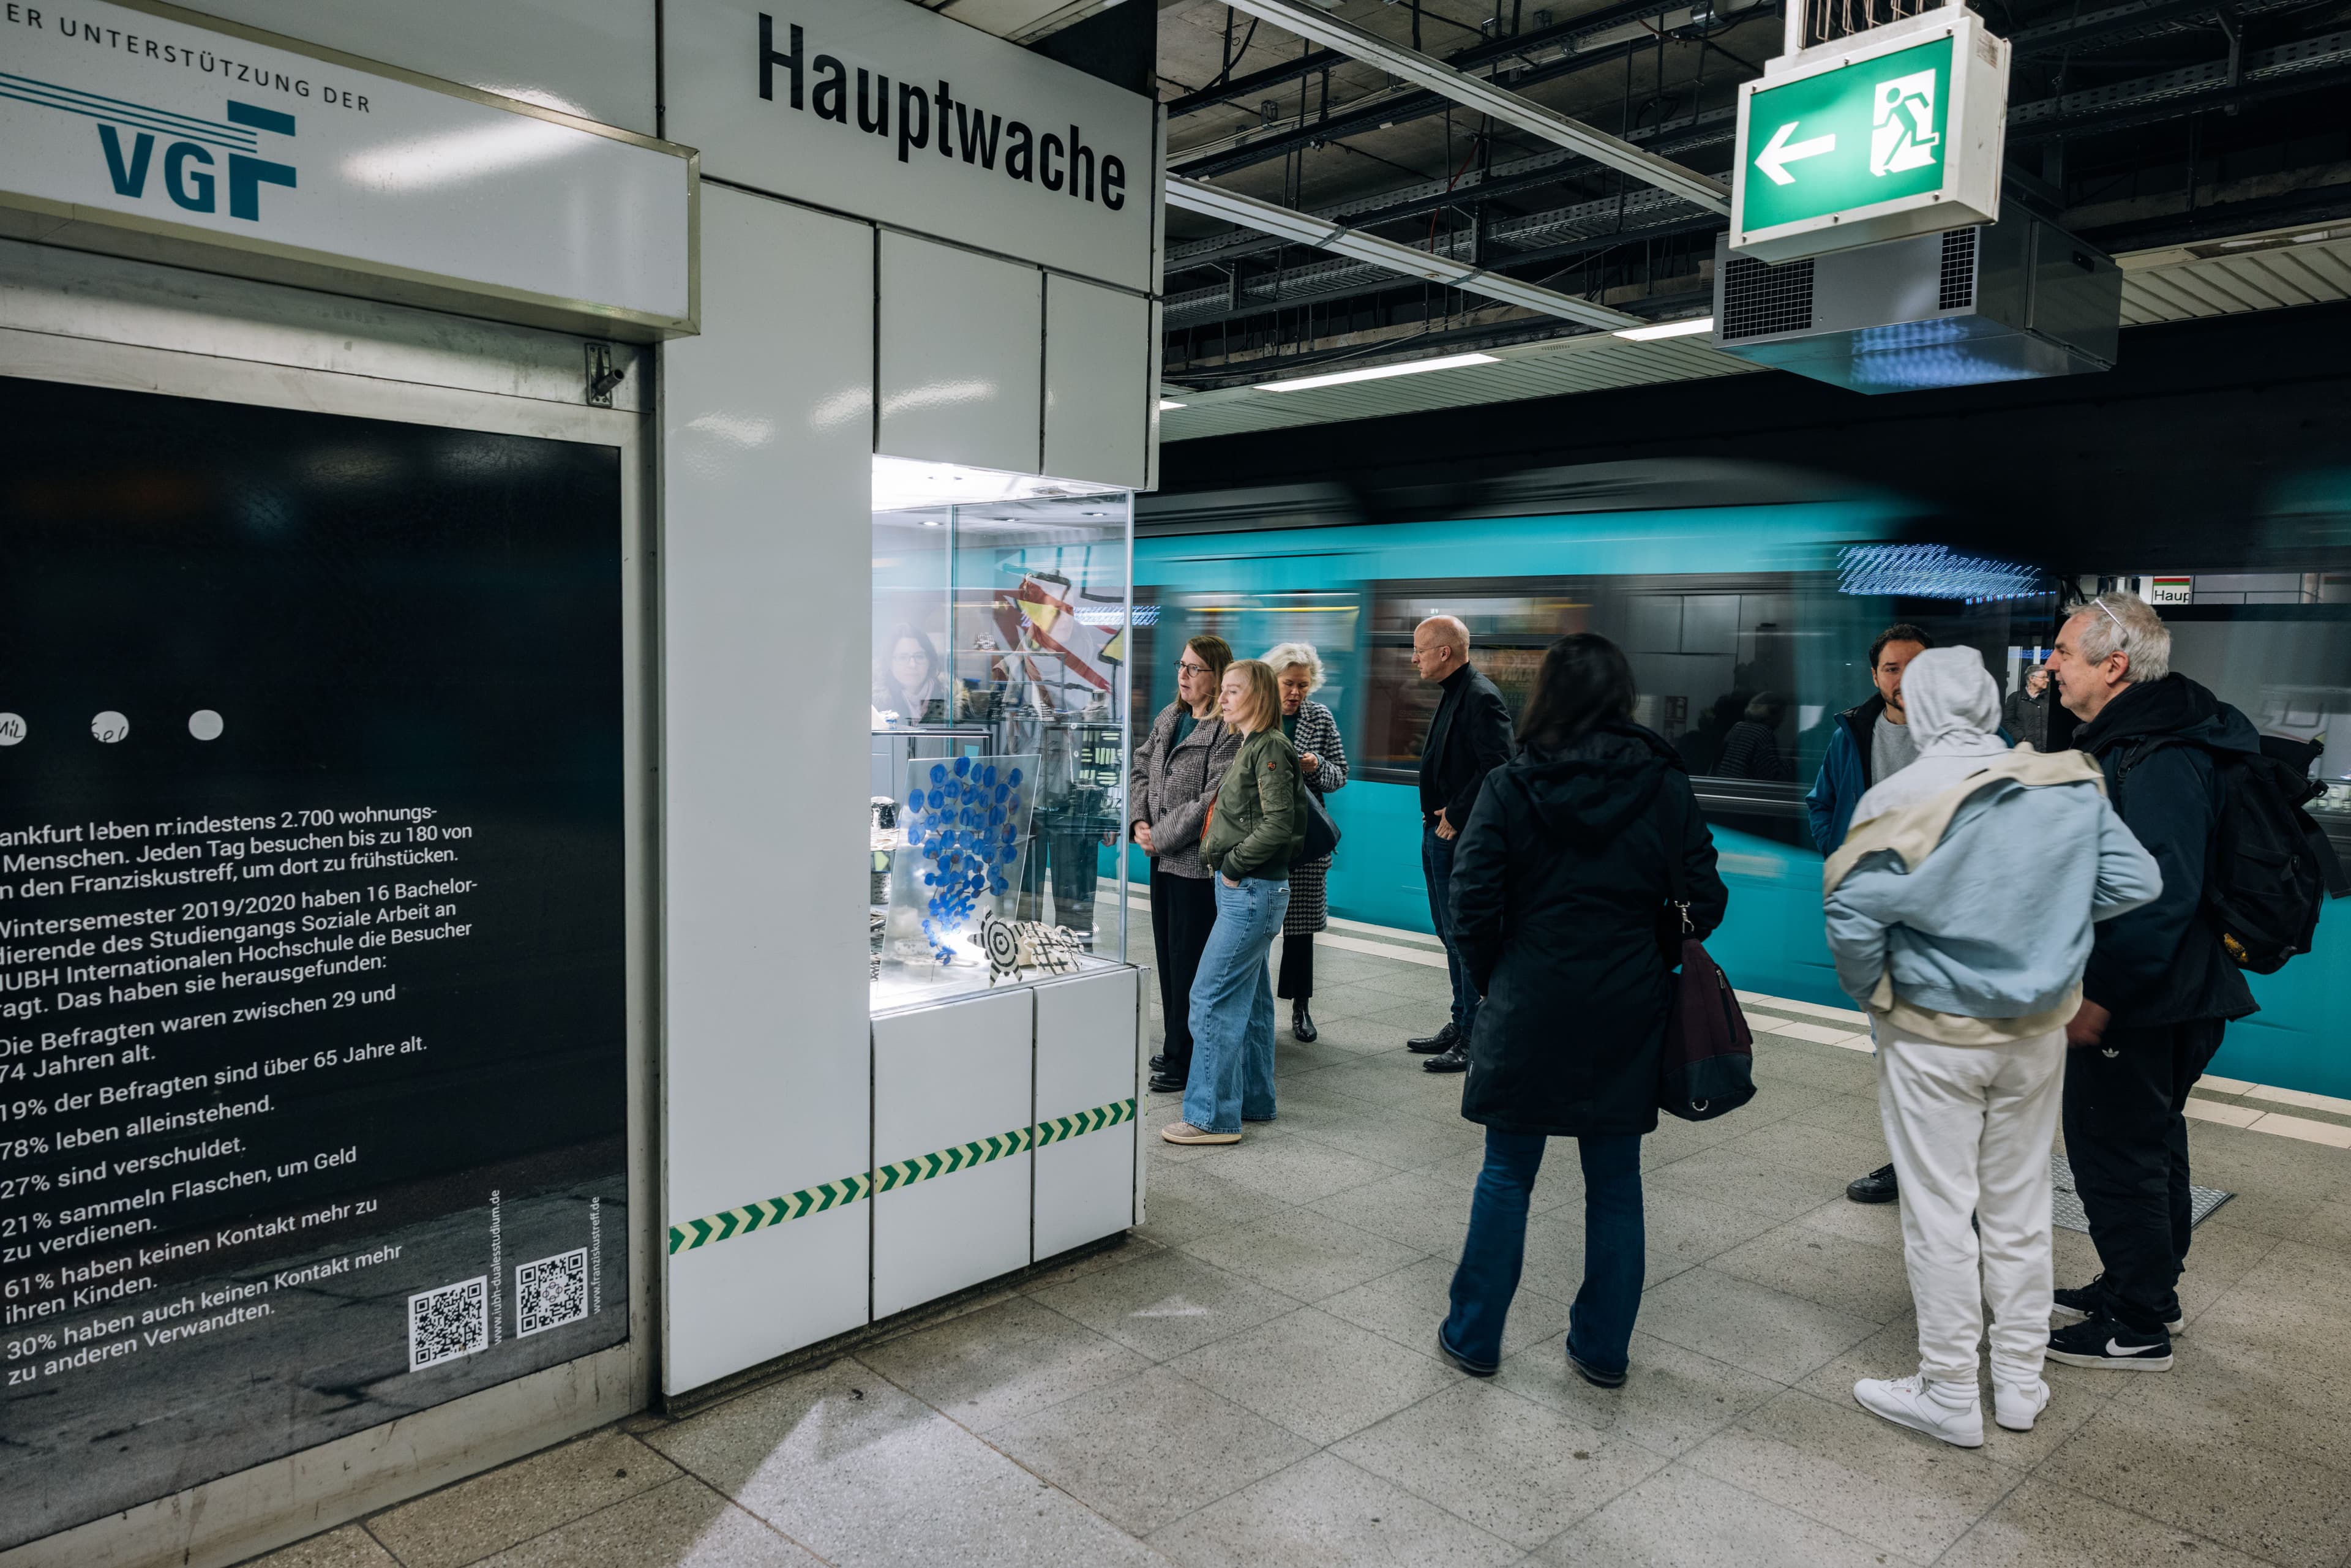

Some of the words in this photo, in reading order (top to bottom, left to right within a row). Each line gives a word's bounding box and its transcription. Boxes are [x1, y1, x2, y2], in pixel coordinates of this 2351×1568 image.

[6, 3, 43, 30] ER
[60, 17, 310, 98] UNTERSTÜTZUNG
[323, 86, 370, 113] DER
[758, 12, 1126, 212] Hauptwache
[97, 99, 297, 222] VGF
[3, 848, 130, 873] Menschen.
[136, 842, 201, 863] Jeden
[206, 840, 245, 860] Tag
[250, 833, 343, 854] besuchen
[348, 829, 376, 847] bis
[380, 831, 401, 845] zu
[406, 825, 438, 842] 180
[441, 826, 473, 840] von
[89, 820, 149, 841] leben
[280, 809, 334, 828] 2.700
[338, 806, 438, 825] wohnungs-
[20, 878, 64, 898] den
[70, 862, 238, 894] Franziskustreff,
[242, 864, 274, 879] um
[279, 857, 319, 876] dort
[323, 858, 345, 872] zu
[349, 847, 459, 869] frühstücken.
[181, 893, 296, 921] 2019/2020
[301, 889, 361, 909] haben
[367, 885, 390, 902] 16
[394, 877, 478, 899] Bachelor-
[67, 949, 233, 984] Internationalen
[238, 934, 354, 963] Hochschule
[358, 930, 386, 948] die
[391, 921, 473, 945] Besucher
[102, 934, 143, 954] des
[149, 920, 296, 948] Studiengangs
[301, 909, 372, 932] Soziale
[375, 902, 430, 924] Arbeit
[435, 904, 456, 917] an
[57, 992, 102, 1011] Das
[108, 981, 178, 1004] haben
[185, 974, 216, 994] sie
[222, 955, 387, 989] herausgefunden:
[0, 1036, 34, 1057] Die
[41, 1022, 155, 1051] Befragten
[160, 1011, 227, 1033] waren
[232, 997, 327, 1023] zwischen
[332, 990, 356, 1009] 29
[361, 983, 396, 1004] und
[0, 1062, 26, 1084] 74
[32, 1052, 114, 1078] Jahren
[121, 1043, 156, 1064] alt.
[0, 1098, 48, 1122] 19%
[54, 1092, 93, 1112] der
[99, 1075, 208, 1105] Befragten
[214, 1061, 258, 1086] sind
[264, 1057, 309, 1077] über
[313, 1049, 338, 1068] 65
[342, 1043, 396, 1063] Jahre
[400, 1035, 427, 1054] alt.
[0, 1136, 49, 1161] 78%
[56, 1126, 119, 1150] leben
[126, 1094, 275, 1138] alleinstehend.
[0, 1174, 51, 1199] 27%
[58, 1160, 107, 1187] sind
[113, 1137, 246, 1176] verschuldet.
[1, 1212, 52, 1237] 21%
[59, 1188, 165, 1225] sammeln
[171, 1169, 272, 1201] Flaschen,
[277, 1160, 309, 1178] um
[313, 1146, 357, 1169] Geld
[2, 1244, 31, 1264] zu
[39, 1218, 157, 1254] verdienen.
[4, 1273, 54, 1299] 61%
[61, 1257, 132, 1286] haben
[139, 1239, 210, 1267] keinen
[217, 1216, 296, 1248] Kontakt
[301, 1204, 351, 1228] mehr
[355, 1199, 377, 1215] zu
[489, 1190, 502, 1346] www.iubh-dualesstudium.de
[590, 1196, 601, 1315] www.franziskustreff.de
[6, 1297, 66, 1324] ihren
[73, 1277, 157, 1308] Kinden.
[7, 1334, 57, 1360] 30%
[64, 1315, 134, 1345] haben
[141, 1297, 195, 1324] auch
[201, 1281, 268, 1309] keinen
[274, 1257, 350, 1290] Kontakt
[355, 1245, 402, 1269] mehr
[8, 1365, 36, 1386] zu
[44, 1339, 137, 1376] anderen
[143, 1304, 275, 1347] Verwandten.
